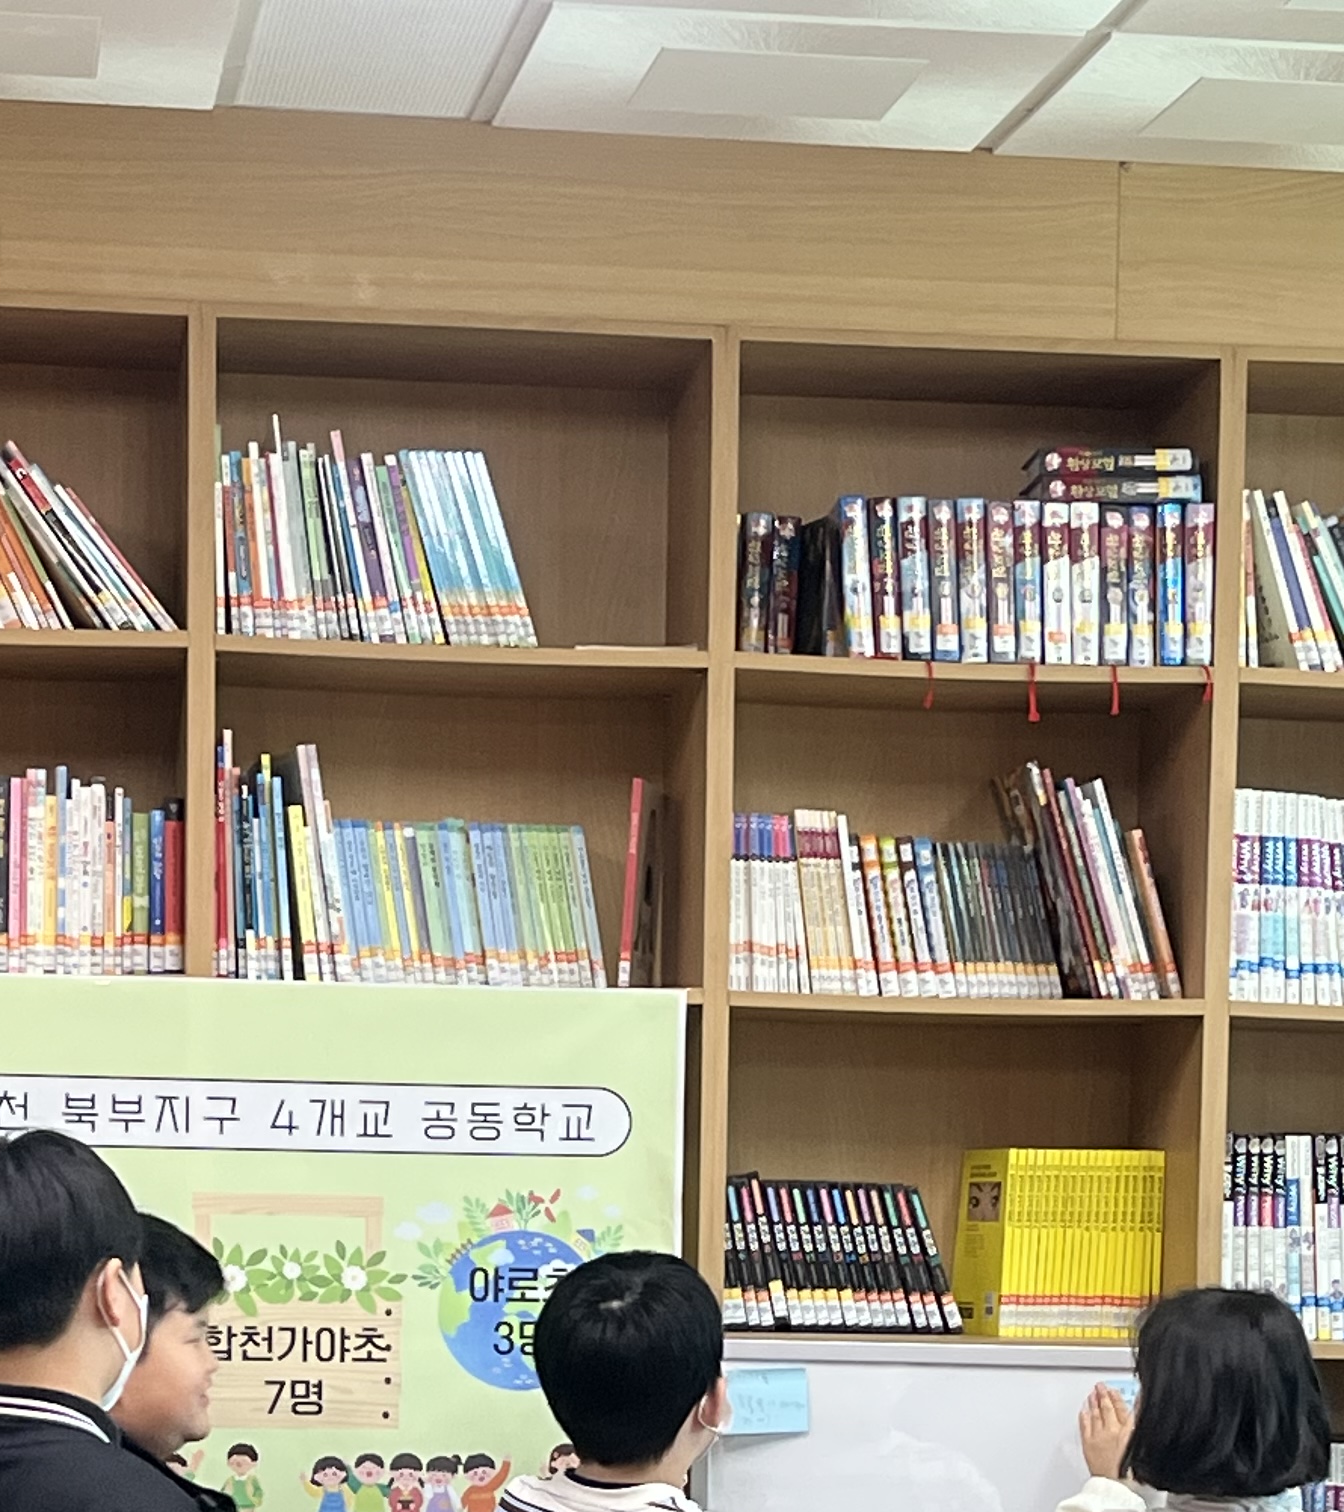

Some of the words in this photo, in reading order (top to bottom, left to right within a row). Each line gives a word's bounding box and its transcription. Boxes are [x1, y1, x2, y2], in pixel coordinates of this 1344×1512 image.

[60, 1094, 244, 1137] 북부지구
[268, 1096, 394, 1140] 4개교
[421, 1100, 597, 1145] 공동학교
[203, 1325, 390, 1367] 합천가야초
[264, 1378, 324, 1418] 7명
